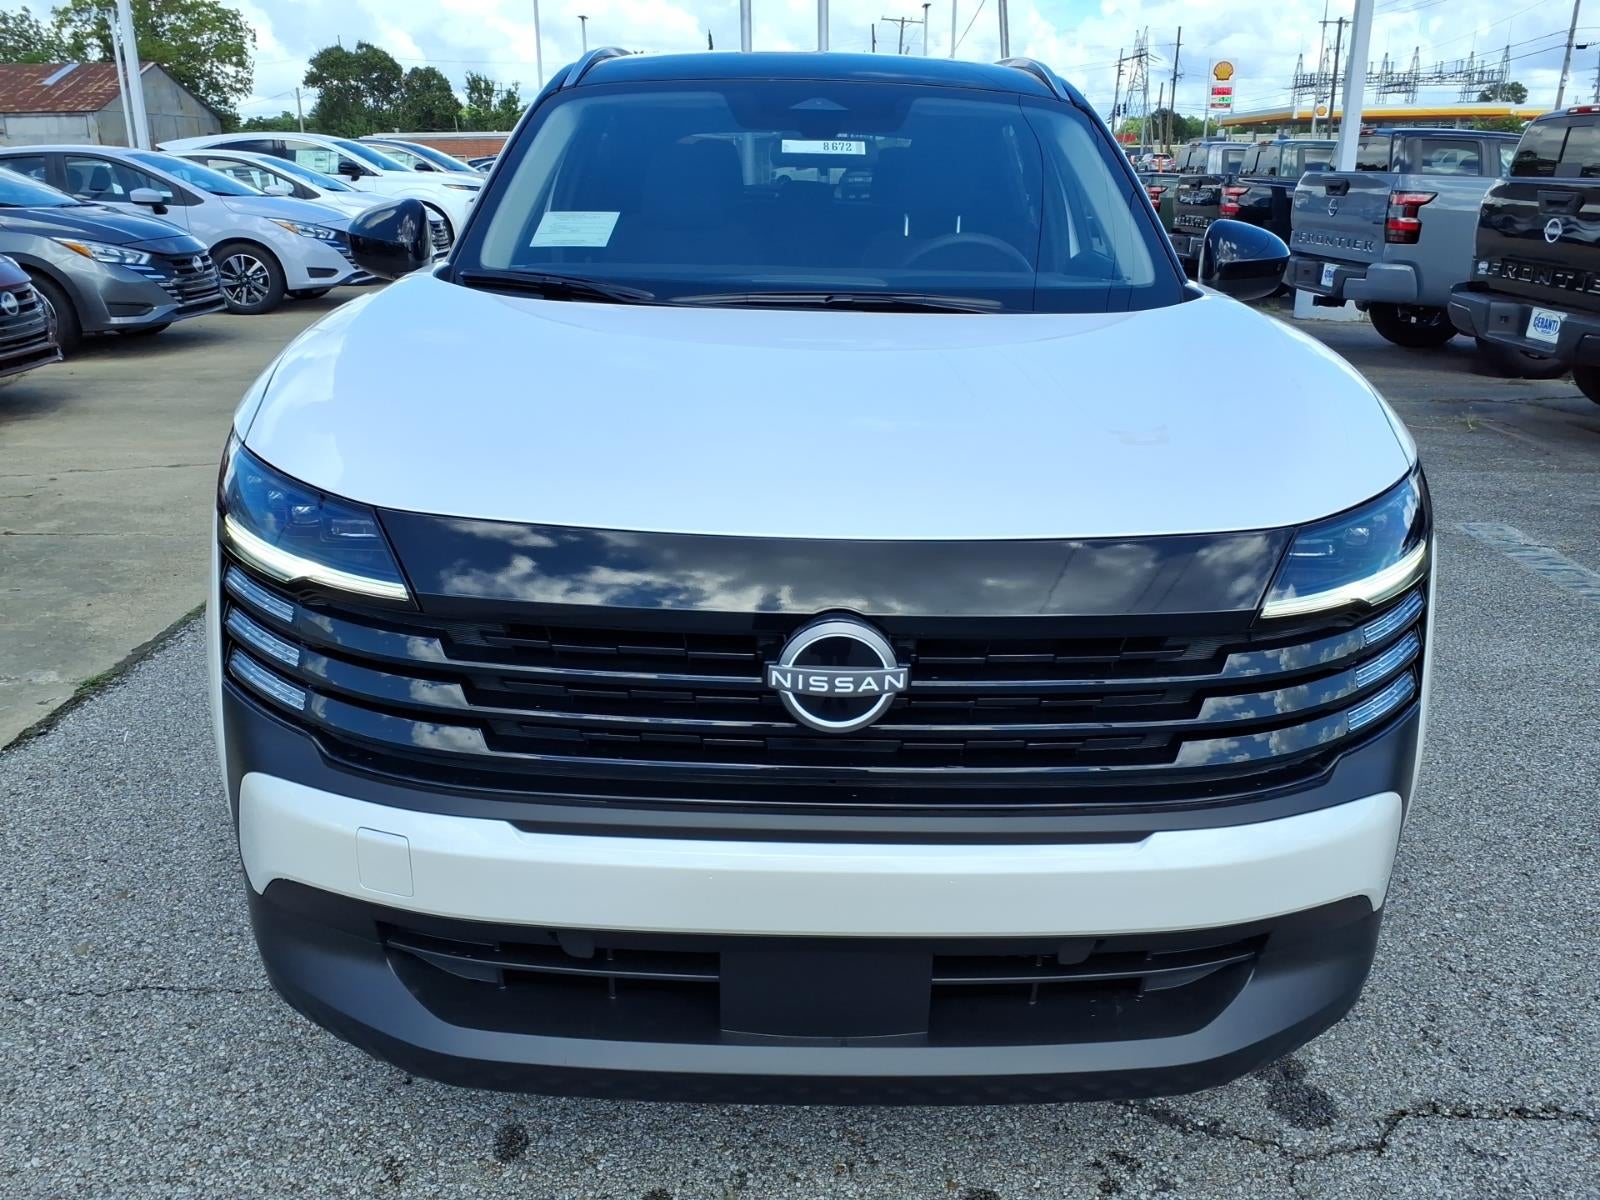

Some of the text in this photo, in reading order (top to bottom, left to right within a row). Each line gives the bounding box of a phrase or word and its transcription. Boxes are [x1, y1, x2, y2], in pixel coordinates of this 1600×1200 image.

[823, 142, 852, 152] 8672
[1298, 232, 1374, 253] FRONTIER
[771, 670, 904, 693] NISSAN
